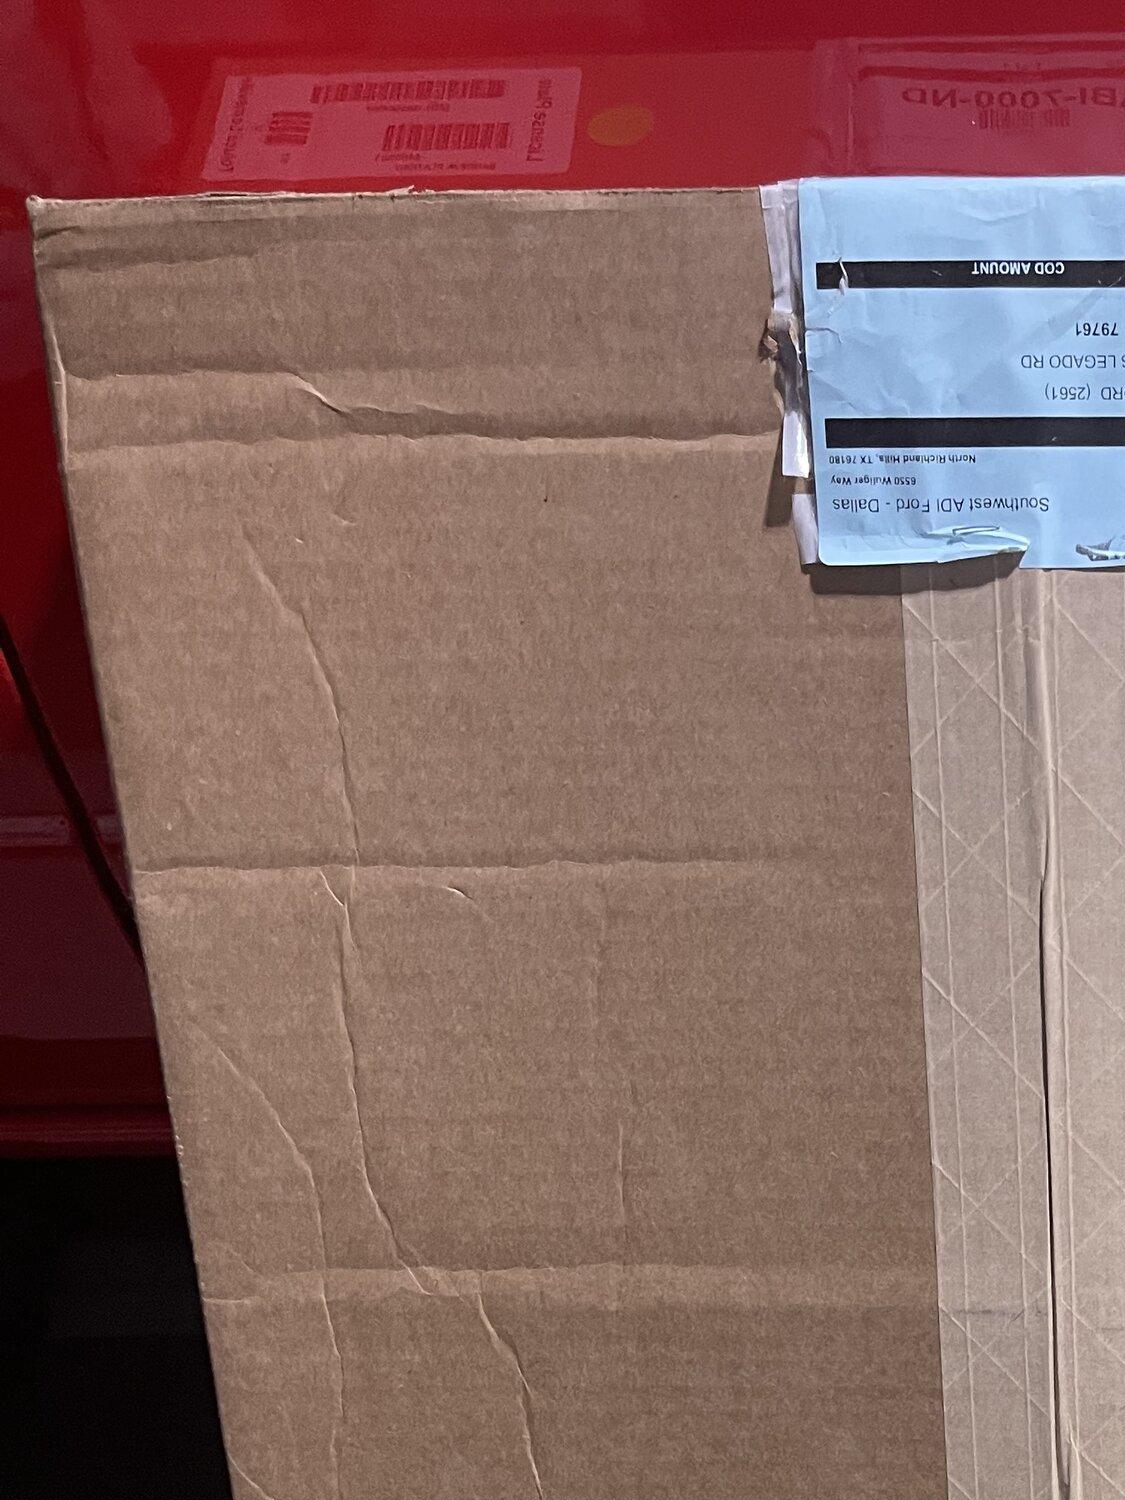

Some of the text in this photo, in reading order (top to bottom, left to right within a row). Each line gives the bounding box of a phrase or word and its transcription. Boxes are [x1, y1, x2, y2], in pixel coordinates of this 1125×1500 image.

[971, 261, 1066, 274] COD AMOUNT
[1075, 322, 1119, 336] 79761
[1021, 354, 1044, 368] RD
[1048, 354, 1117, 369] LEGADO
[1045, 383, 1091, 401] (2561)
[829, 453, 976, 464] North Richland Hills, TX 76180
[830, 474, 851, 486] Way
[893, 476, 917, 486] 6550
[832, 498, 880, 513] Dallas
[896, 497, 930, 512] Ford
[936, 497, 964, 512] ADI
[968, 497, 1050, 513] Southwest
